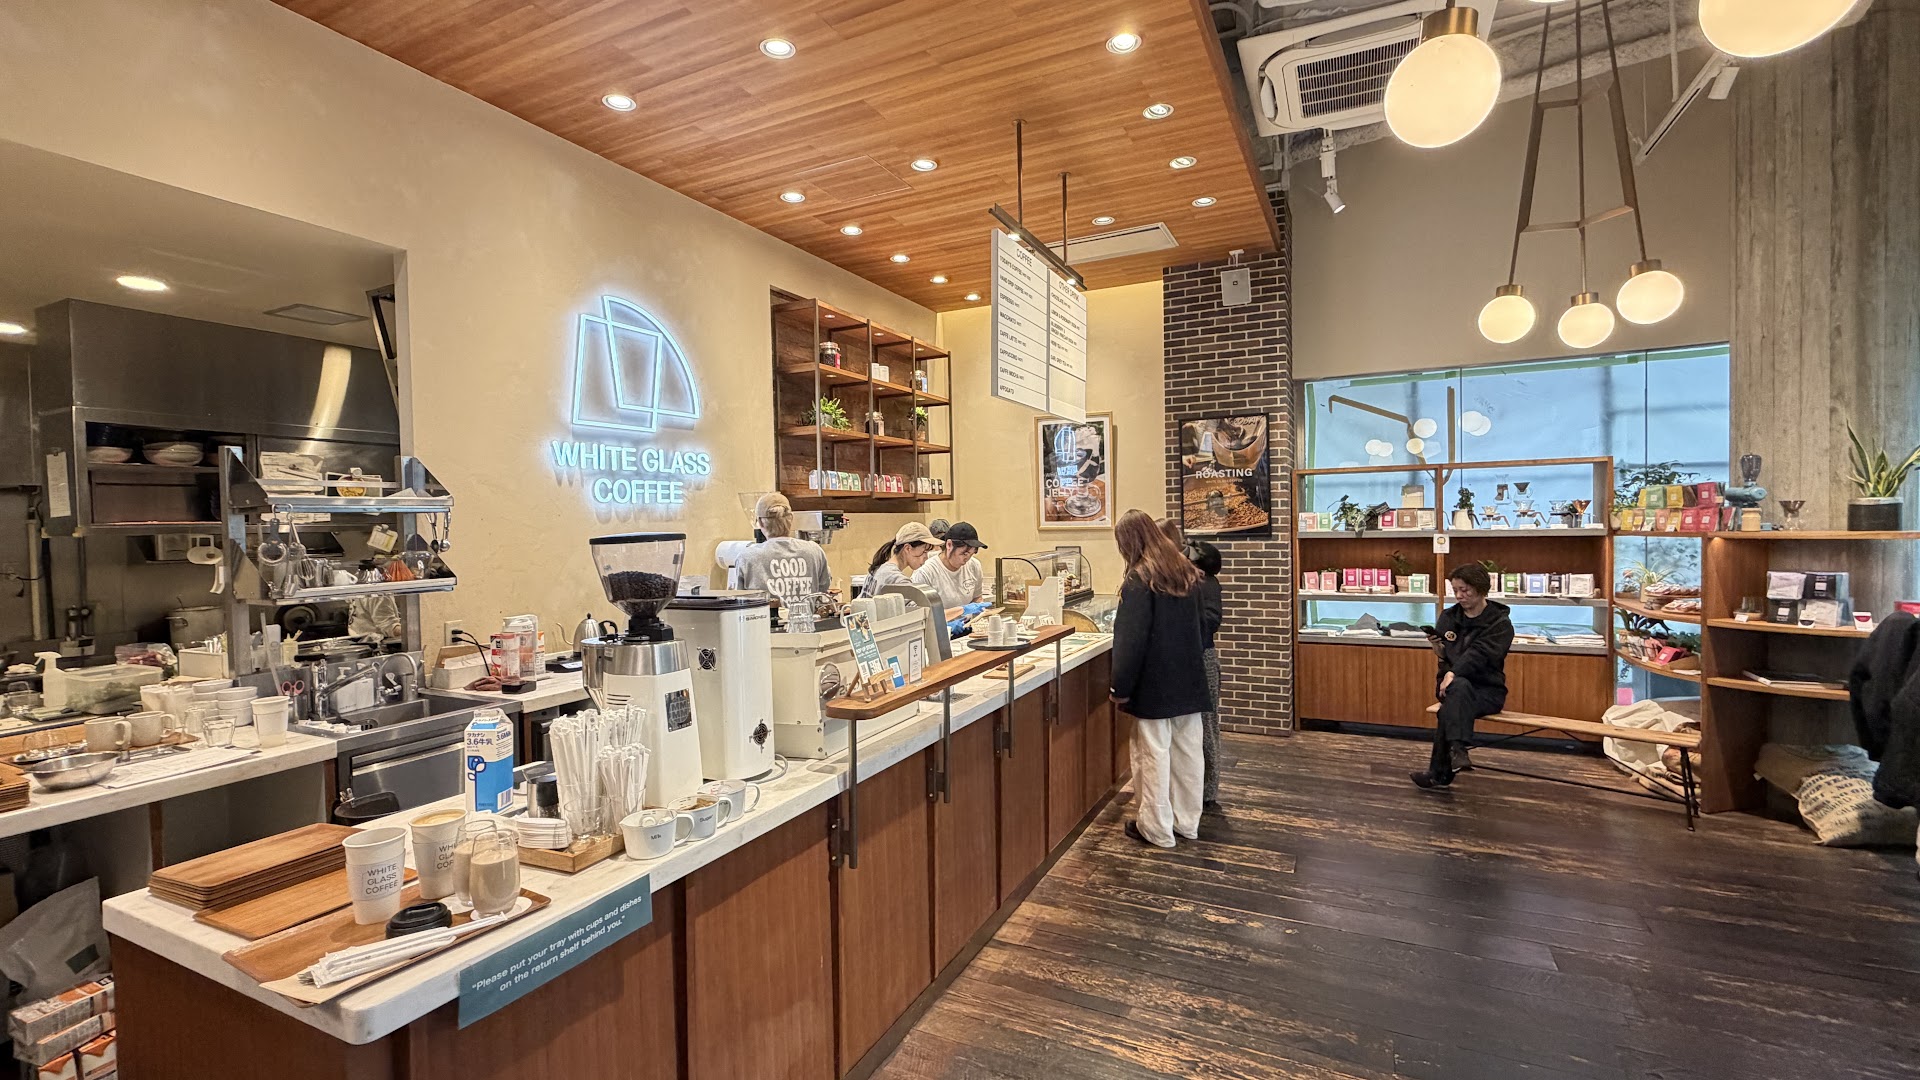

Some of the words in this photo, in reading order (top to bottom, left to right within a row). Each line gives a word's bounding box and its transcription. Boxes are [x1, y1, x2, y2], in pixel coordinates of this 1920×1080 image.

[1017, 249, 1032, 267] COFFEE
[552, 440, 638, 471] WHITE
[642, 448, 711, 476] GLASS
[1195, 468, 1253, 479] ROASTING
[594, 478, 684, 504] COFFEE
[770, 558, 807, 578] GOOD
[767, 577, 812, 597] COFFEE
[466, 738, 494, 746] 3.6牛乳
[438, 851, 455, 861] GLA
[367, 863, 397, 876] WHITE
[436, 860, 454, 870] COF
[367, 872, 397, 886] GLASS
[365, 880, 398, 895] COFFEE
[472, 970, 508, 991] "Please
[510, 959, 526, 974] put
[527, 947, 549, 967] your
[549, 937, 567, 953] tray
[567, 927, 585, 944] with
[585, 918, 604, 935] cups
[604, 911, 620, 922] and
[619, 895, 642, 913] dishes
[499, 980, 512, 992] on
[513, 970, 530, 984] the
[531, 956, 559, 975] return
[559, 941, 580, 959] shelf
[581, 928, 606, 947] behind
[606, 915, 626, 934] you."
